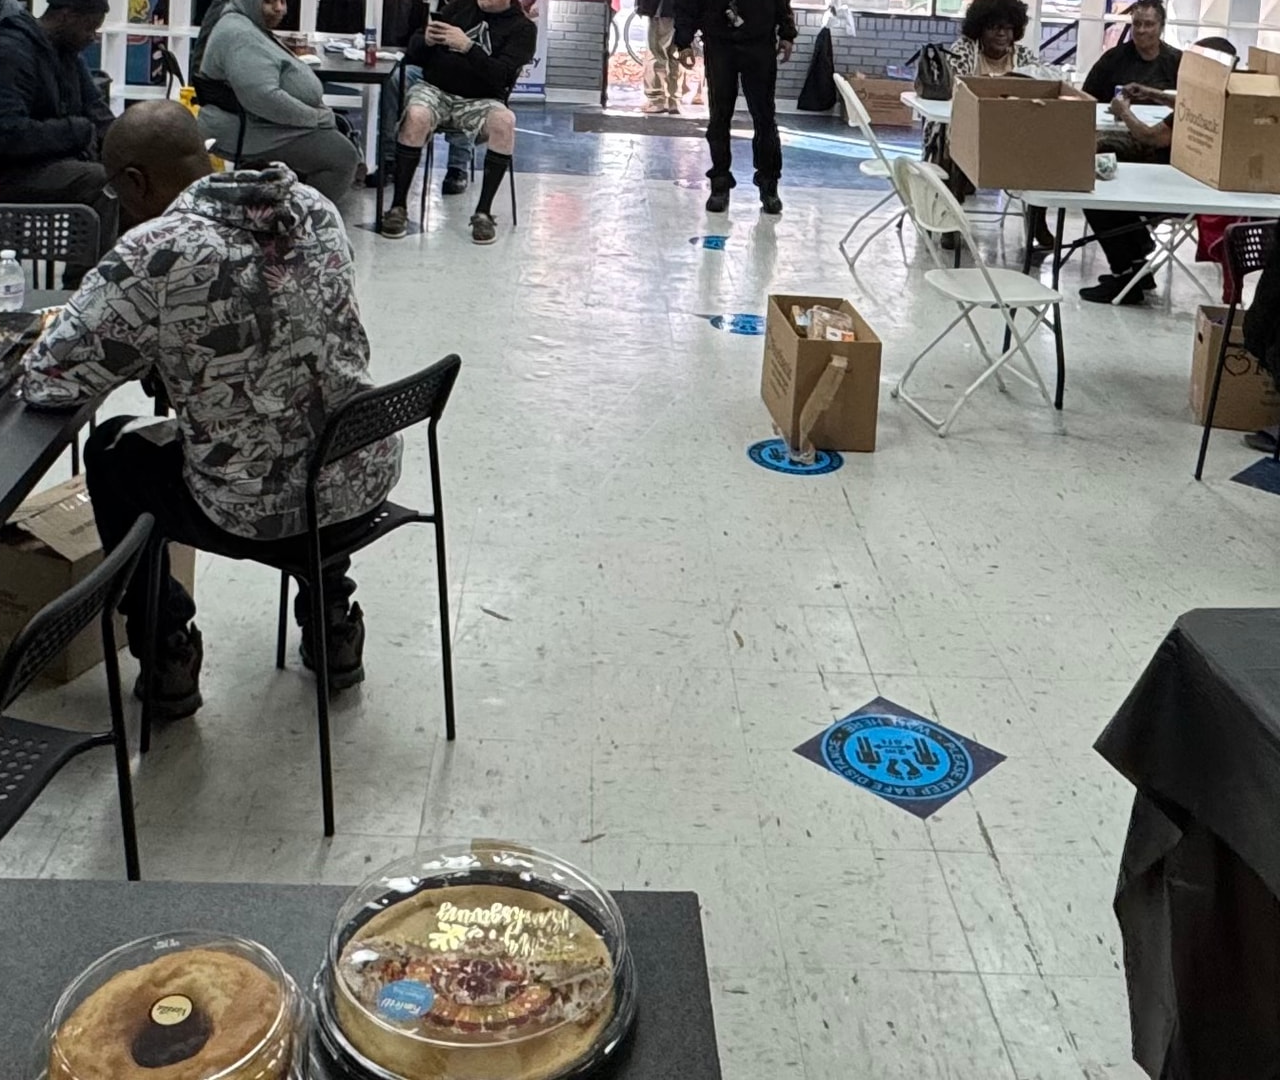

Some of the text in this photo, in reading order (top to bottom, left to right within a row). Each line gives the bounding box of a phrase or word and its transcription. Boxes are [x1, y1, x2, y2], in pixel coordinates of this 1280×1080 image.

[840, 717, 883, 734] HERE
[827, 737, 967, 796] PLEASE KEEP SAFE DISTANCE
